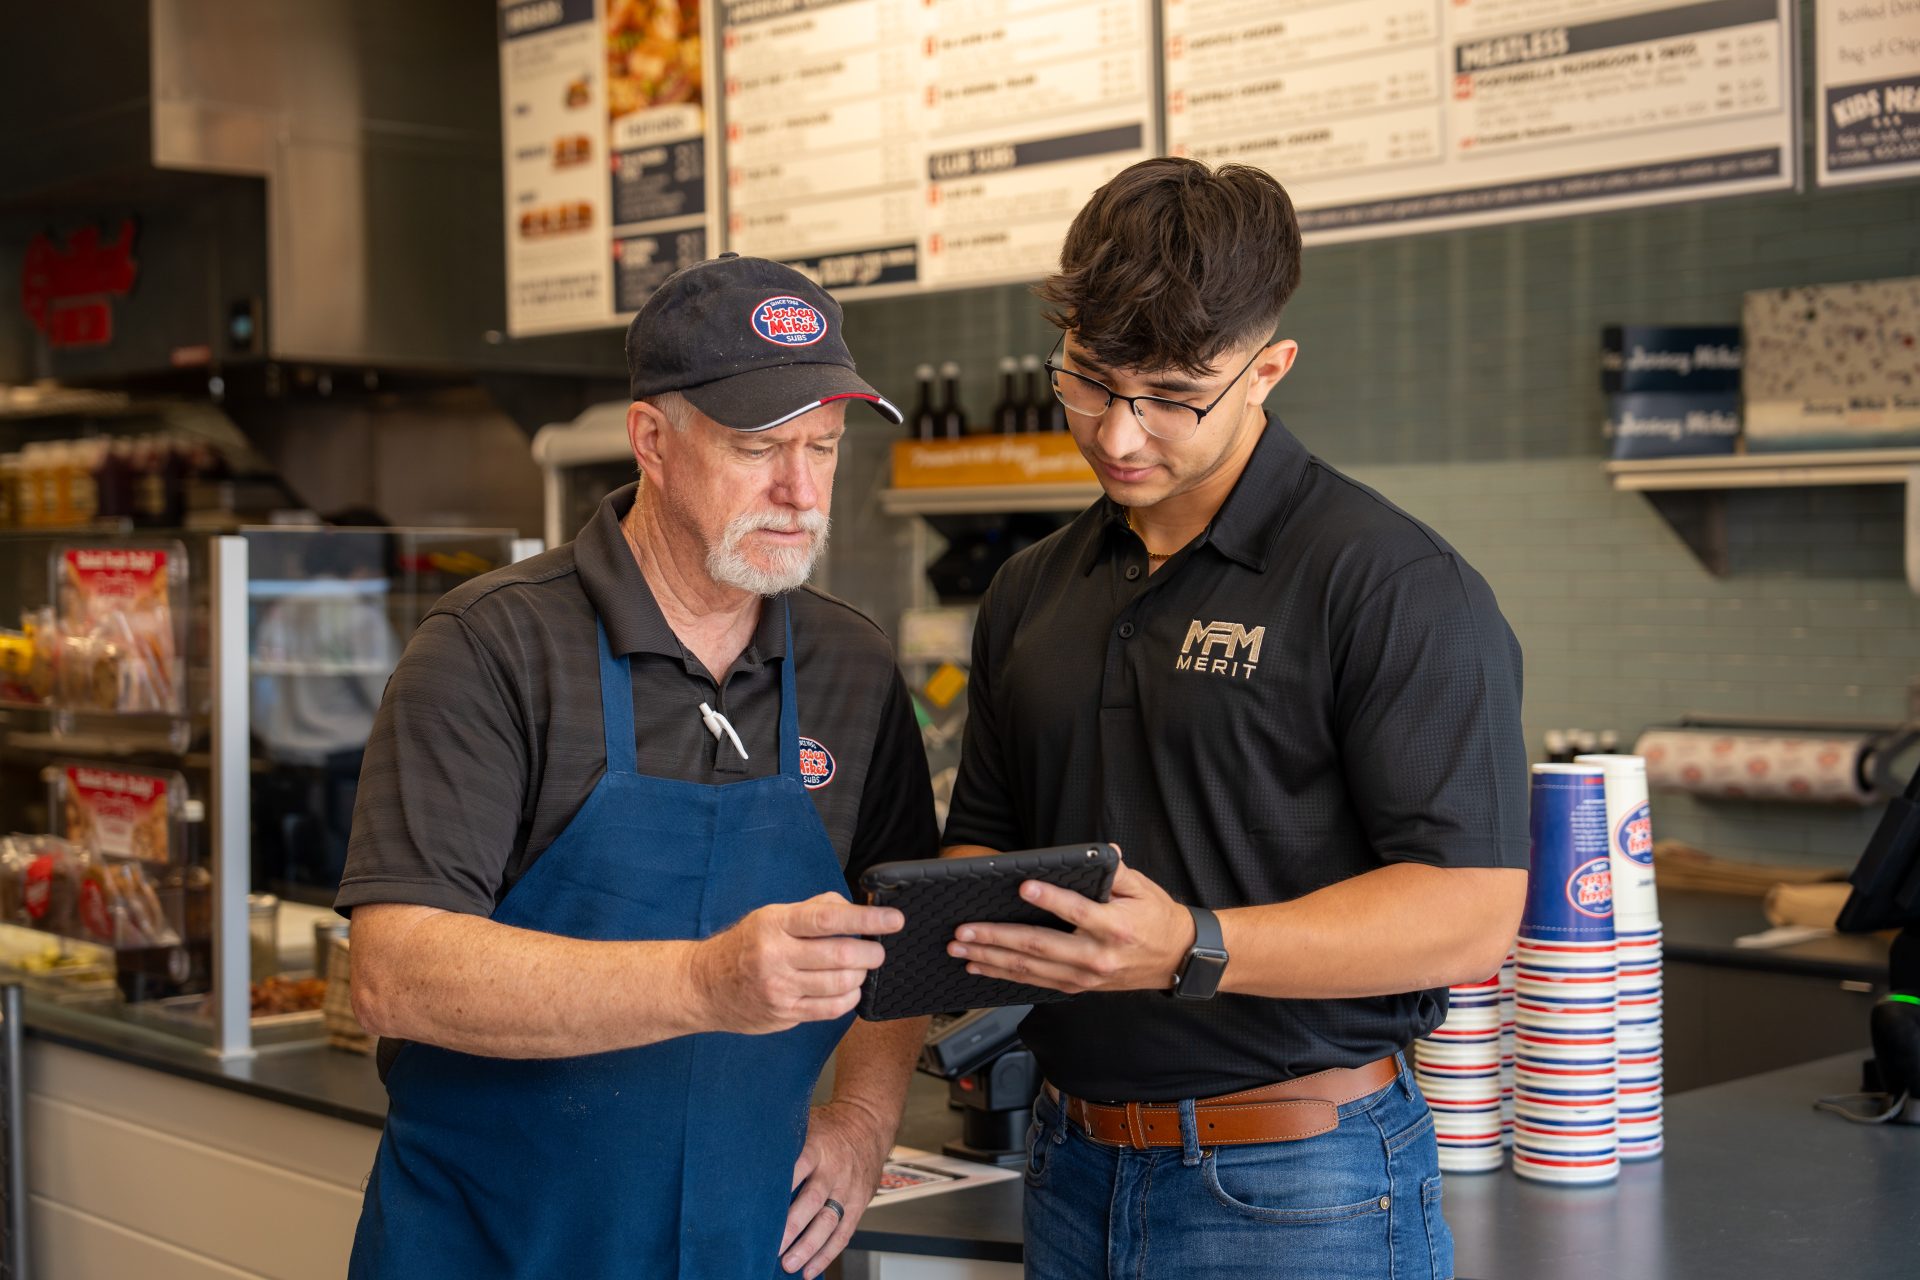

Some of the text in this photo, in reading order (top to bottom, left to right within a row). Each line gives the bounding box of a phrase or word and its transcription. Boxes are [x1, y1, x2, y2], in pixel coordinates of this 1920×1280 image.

[1831, 88, 1882, 129] KIDS
[761, 305, 817, 323] Jersey
[786, 334, 808, 342] SUBS
[1176, 655, 1256, 679] MERIT
